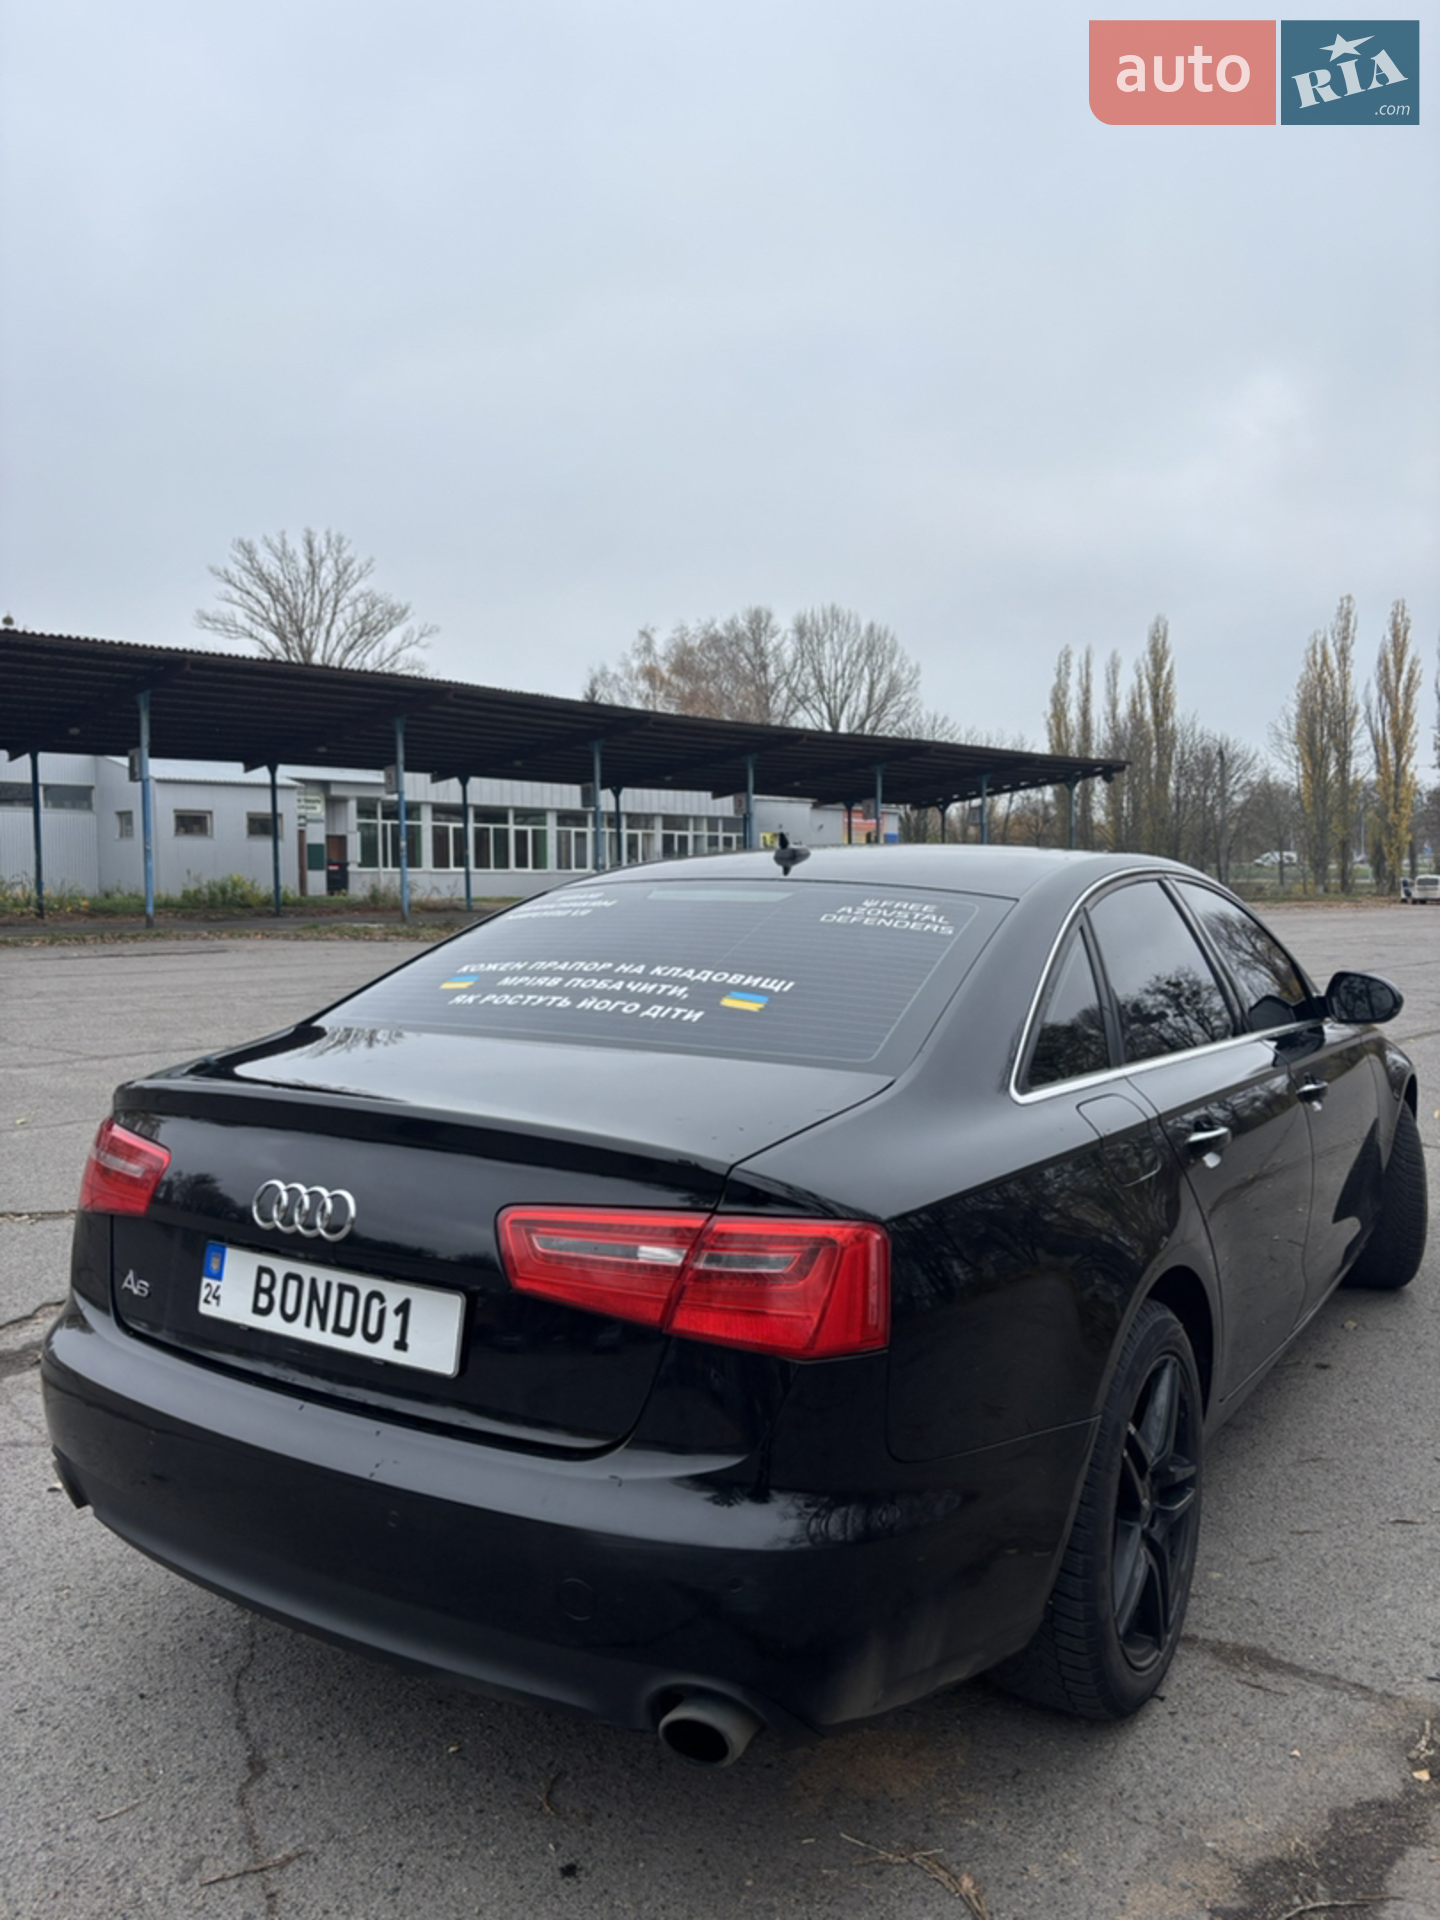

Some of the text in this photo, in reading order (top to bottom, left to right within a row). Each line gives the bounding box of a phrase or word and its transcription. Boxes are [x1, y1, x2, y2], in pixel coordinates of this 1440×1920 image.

[836, 906, 950, 924] AZOVSTAL
[880, 900, 938, 913] FREE
[819, 913, 956, 936] DEFENDERS
[456, 961, 796, 993] КОЖЕН ПРАПОР НА КЛАДОВИЩІ
[496, 975, 690, 1000] МРІЯВ ПОБАЧИТИ,
[448, 993, 705, 1023] ЯК РОСТУТЬ ЙОГО ДІТИ
[121, 1269, 152, 1298] A6
[203, 1282, 223, 1307] 24
[251, 1264, 412, 1352] BOND01
